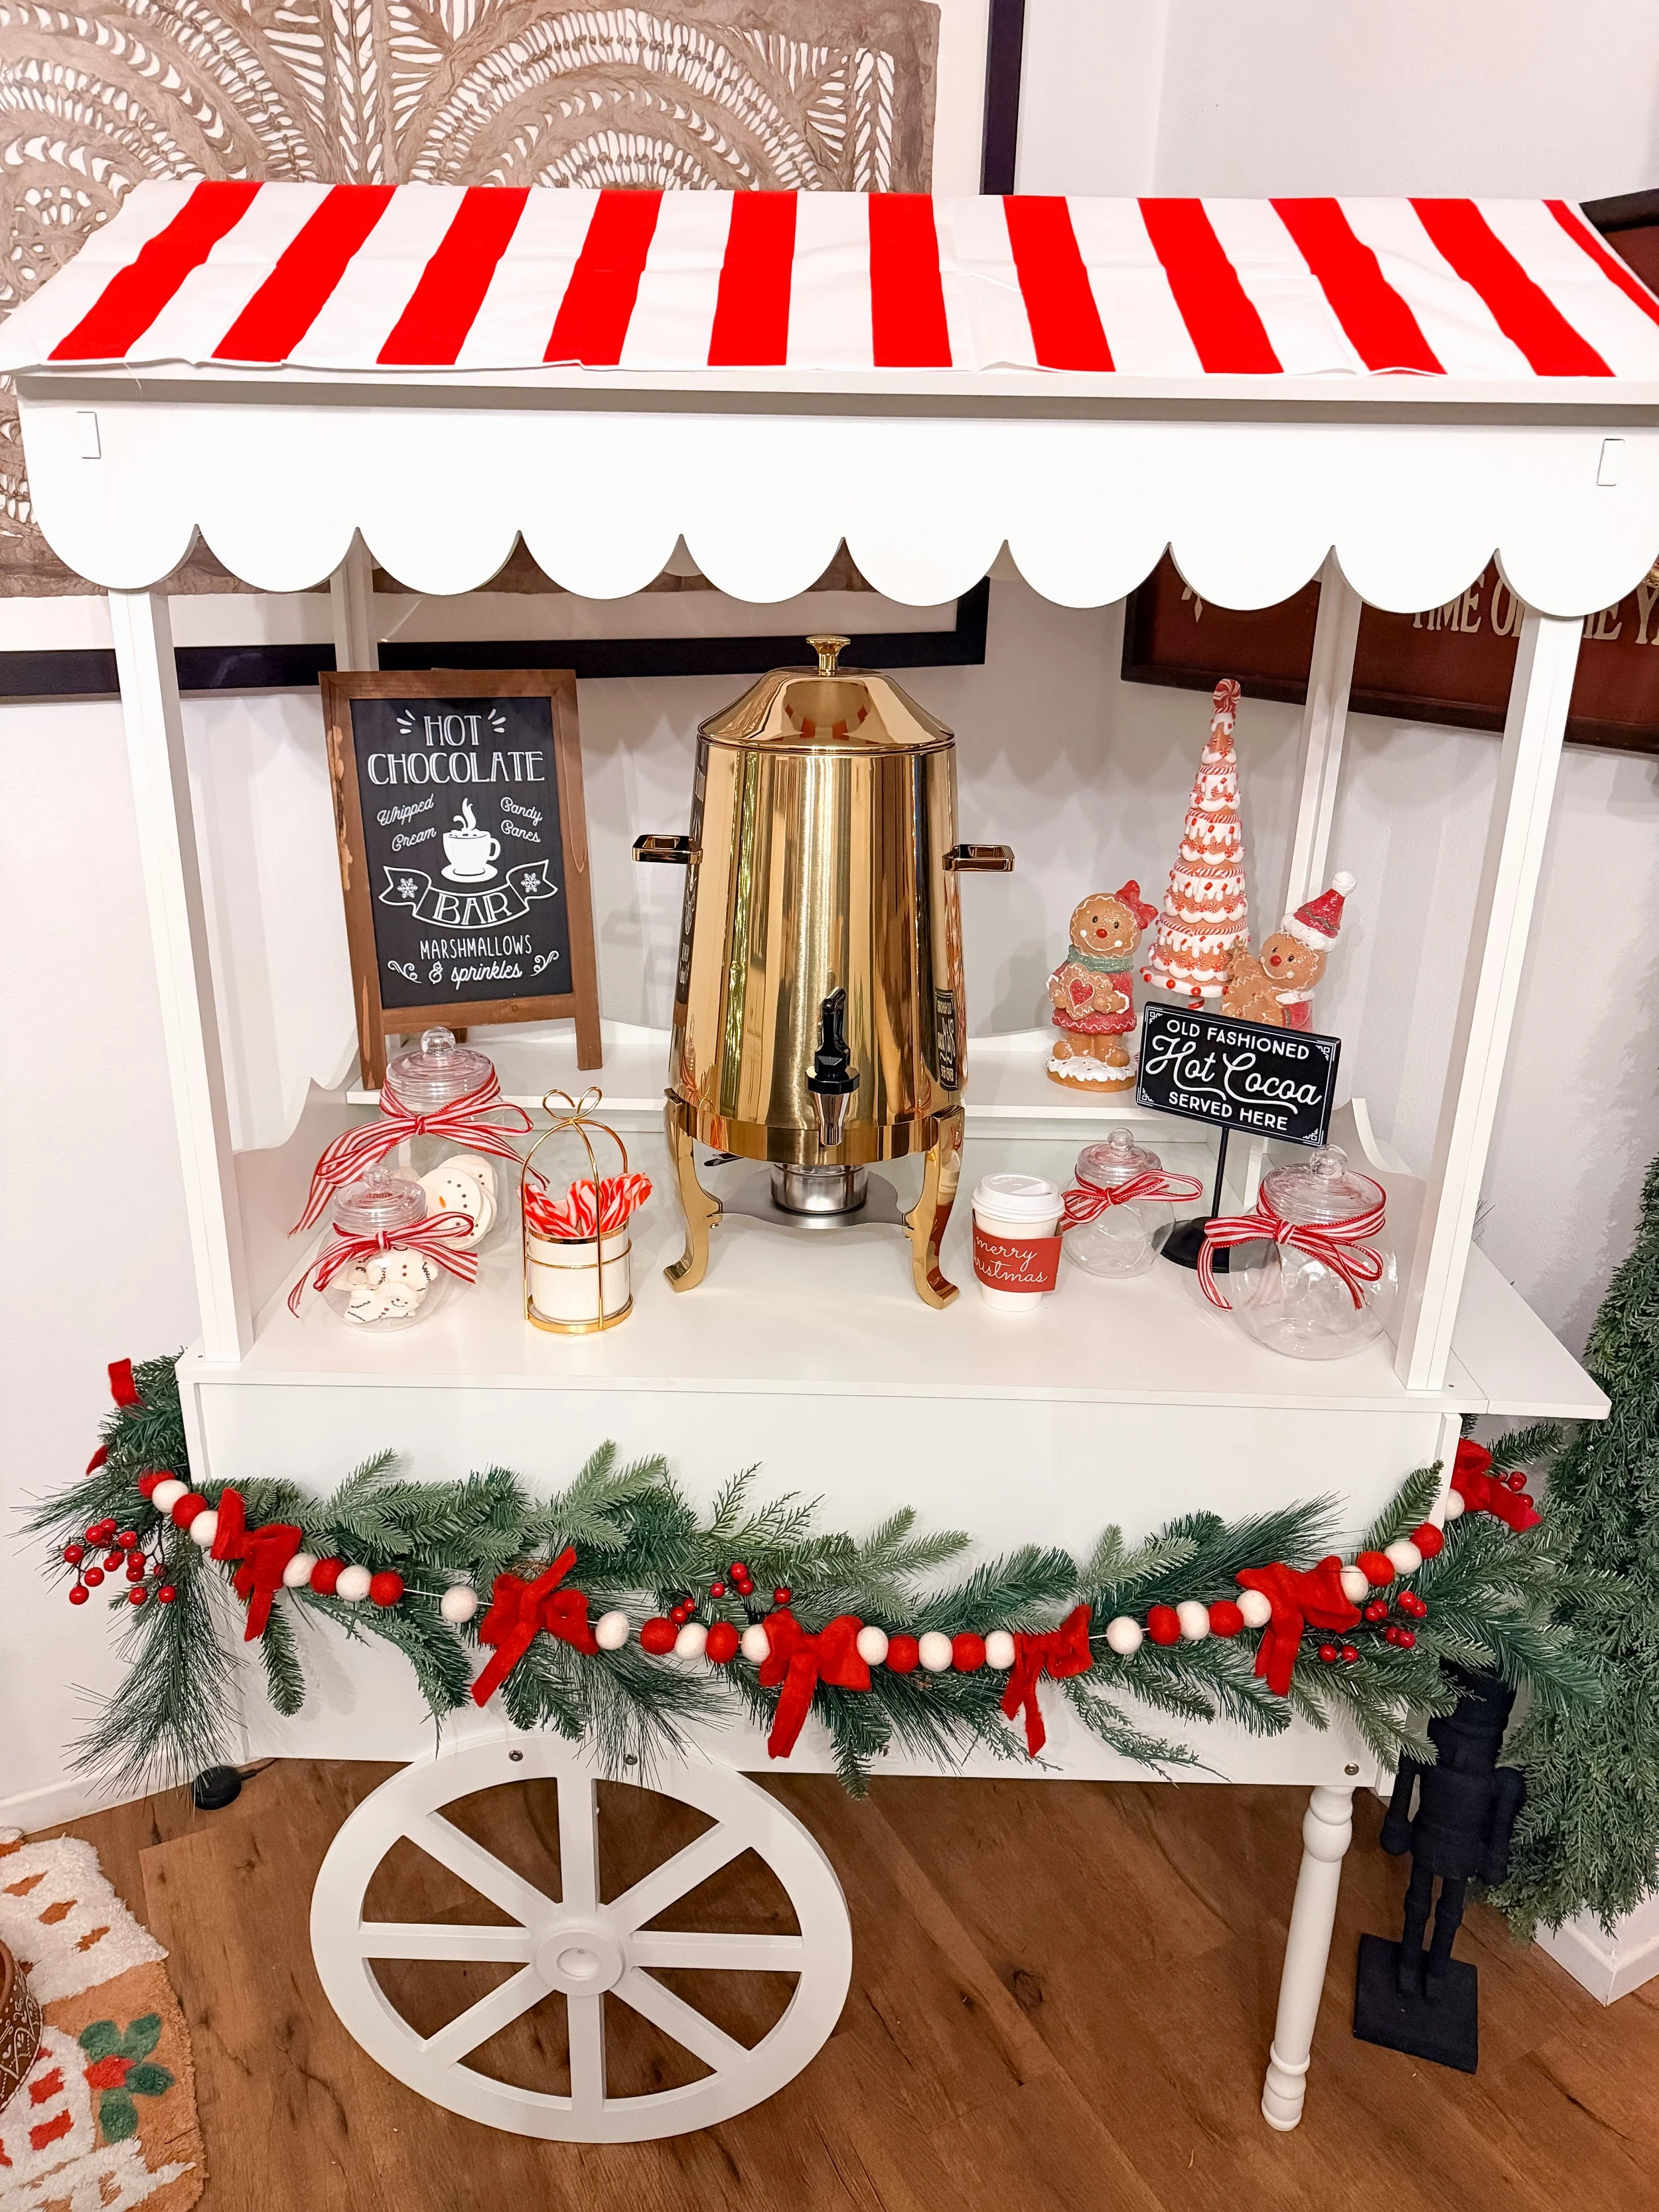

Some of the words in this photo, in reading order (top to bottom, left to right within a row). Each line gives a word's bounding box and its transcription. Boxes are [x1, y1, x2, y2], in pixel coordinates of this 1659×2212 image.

[1413, 573, 1484, 632] ME
[423, 715, 482, 746] HOT
[368, 751, 545, 784] CHOCOLATE
[377, 793, 435, 826] Whipped
[500, 796, 543, 826] Candy
[392, 827, 437, 851] Cream
[500, 820, 541, 843] Canes
[432, 892, 512, 925] BAR
[419, 934, 532, 960] MARSHMALLOWS
[428, 961, 443, 984] &
[451, 960, 523, 990] sprinkles
[1167, 1019, 1200, 1037] OLD
[1206, 1028, 1309, 1060] FASHIONED
[1145, 1035, 1226, 1100] Hot
[1222, 1052, 1323, 1114] Cocoa
[1169, 1091, 1232, 1118] SERVED
[1240, 1108, 1288, 1131] HERE
[976, 1236, 1037, 1272] merry
